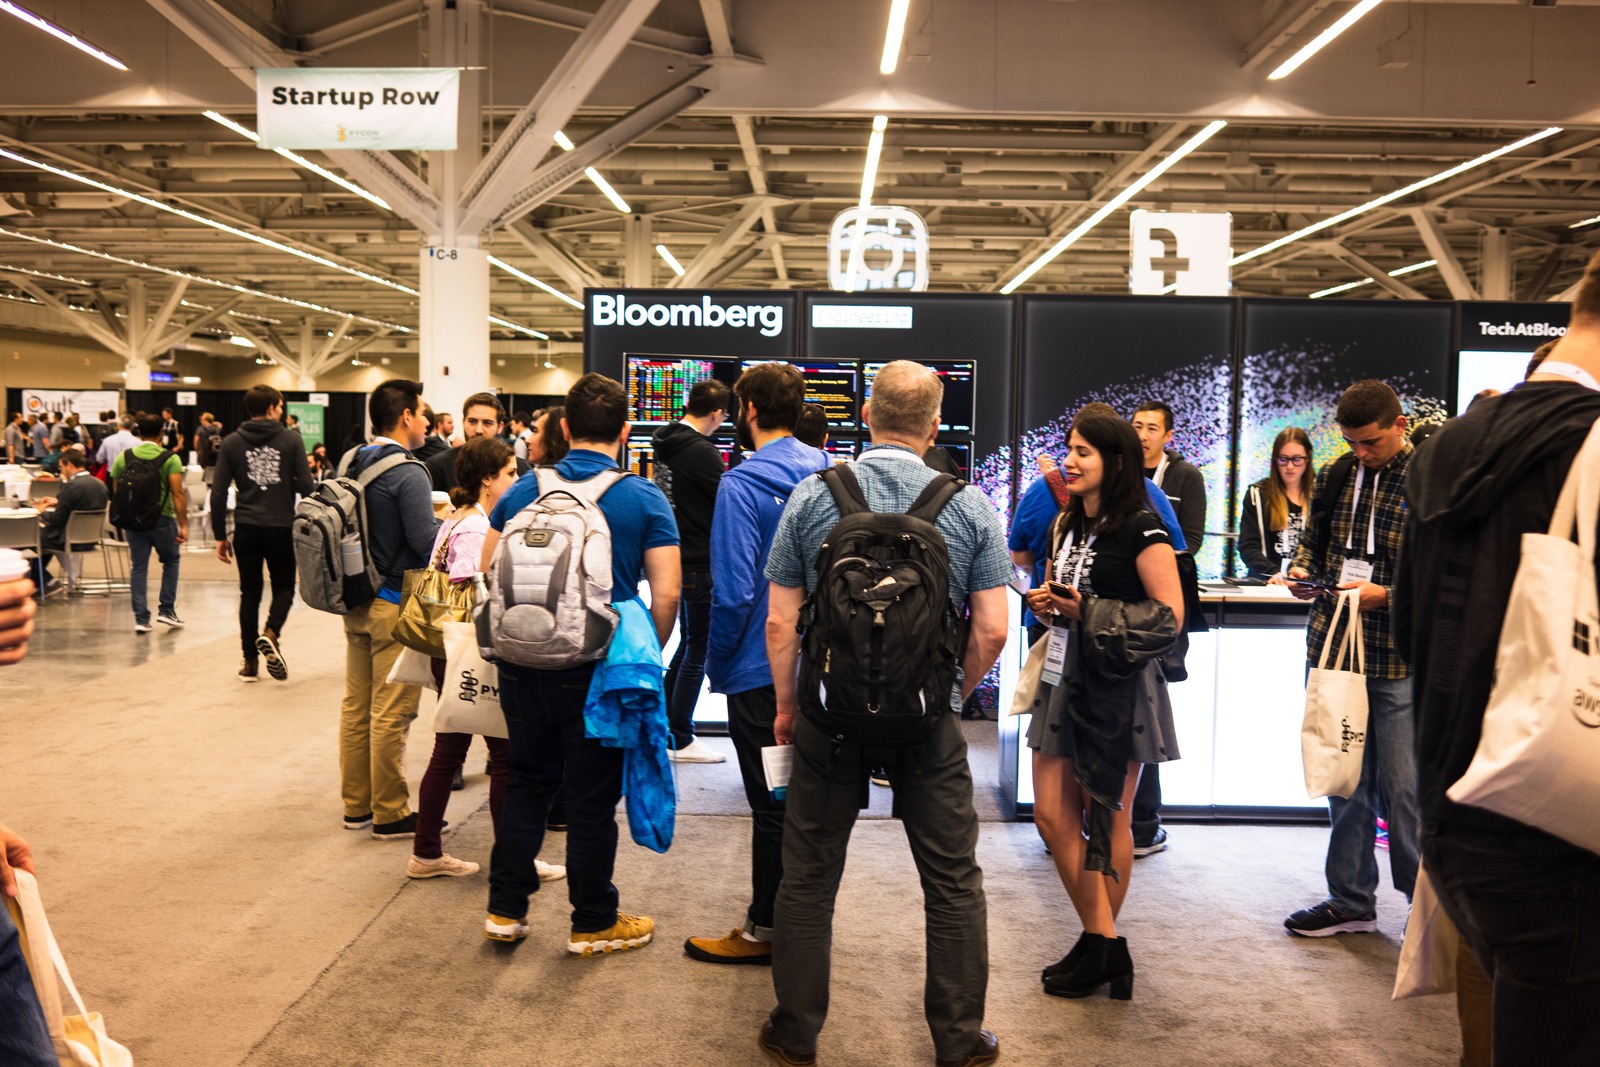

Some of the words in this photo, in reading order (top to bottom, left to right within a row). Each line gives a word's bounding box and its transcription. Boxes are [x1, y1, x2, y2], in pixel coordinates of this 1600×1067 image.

[272, 86, 374, 110] Startup
[382, 87, 440, 105] Row
[436, 249, 458, 260] C-8
[592, 295, 784, 337] Bloomberg
